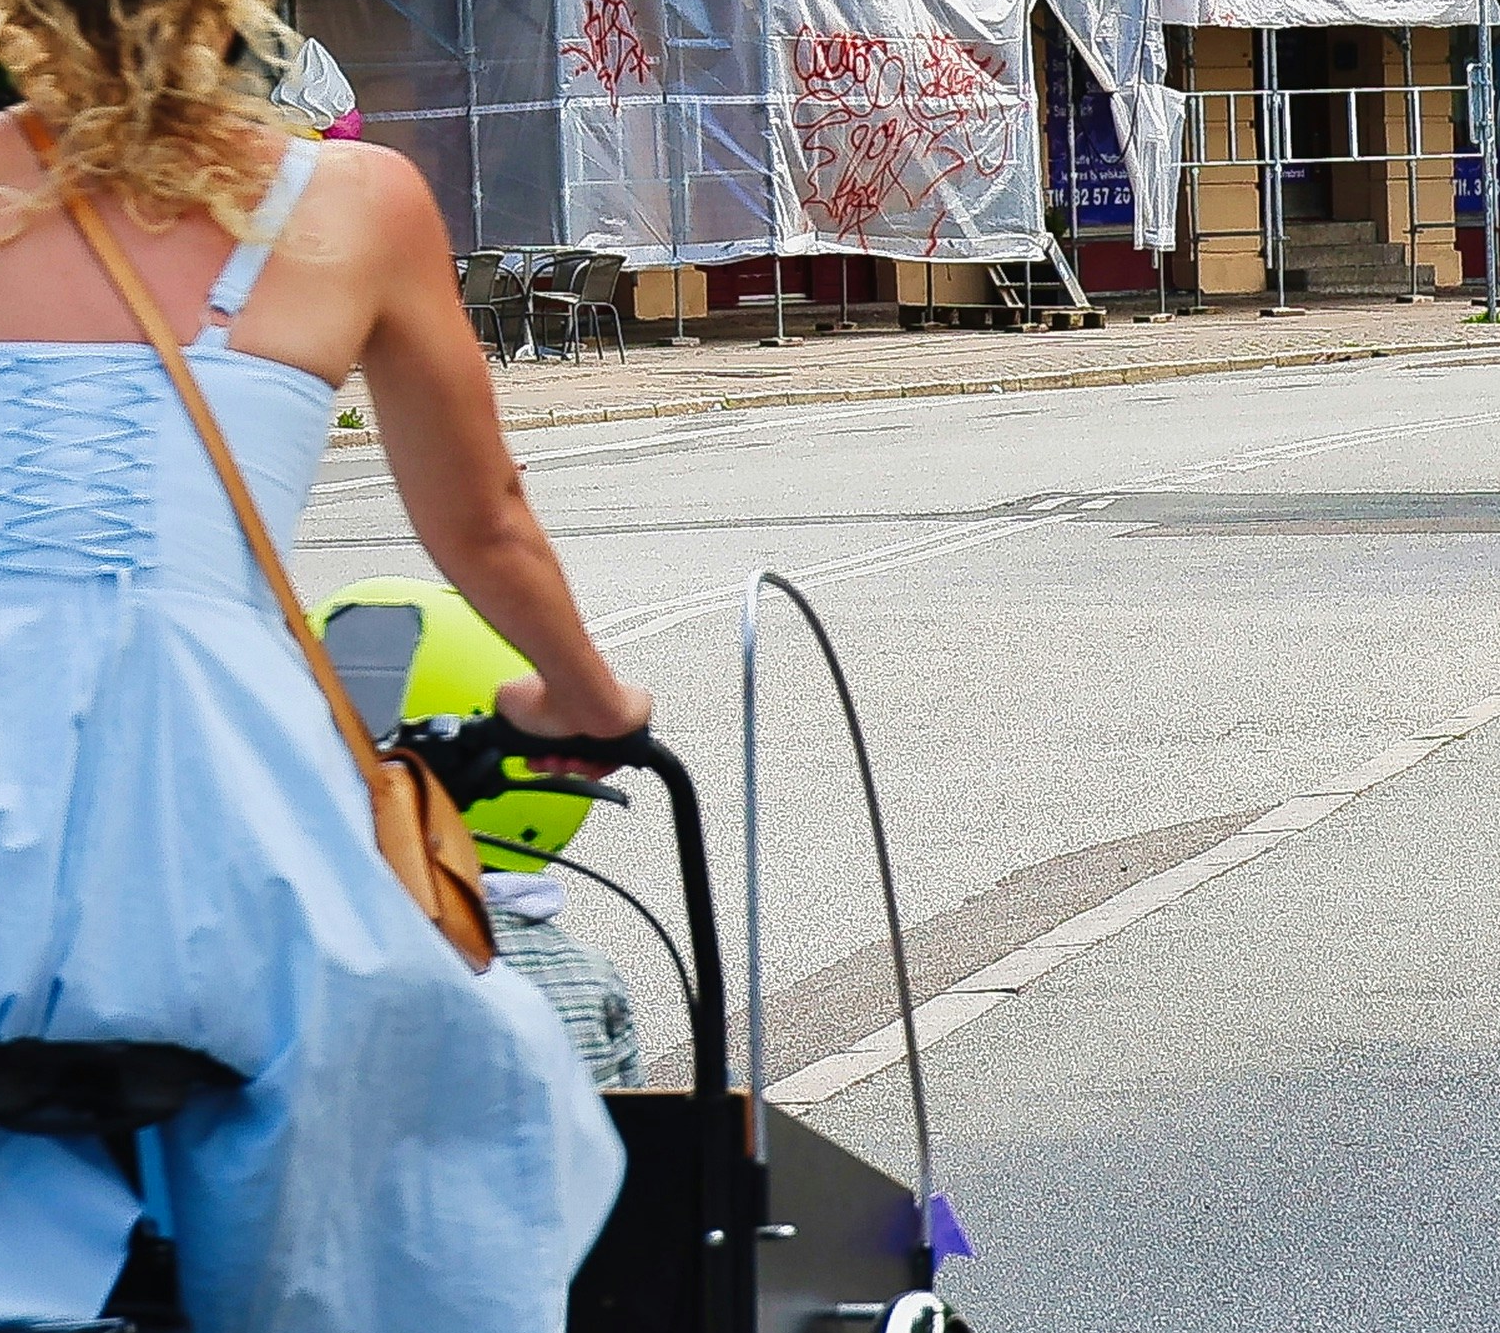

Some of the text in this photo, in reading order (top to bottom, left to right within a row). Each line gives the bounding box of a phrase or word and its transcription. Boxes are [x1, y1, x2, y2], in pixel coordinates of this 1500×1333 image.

[1453, 178, 1471, 196] Tlf.
[1093, 187, 1110, 206] 57
[1113, 187, 1131, 205] 20
